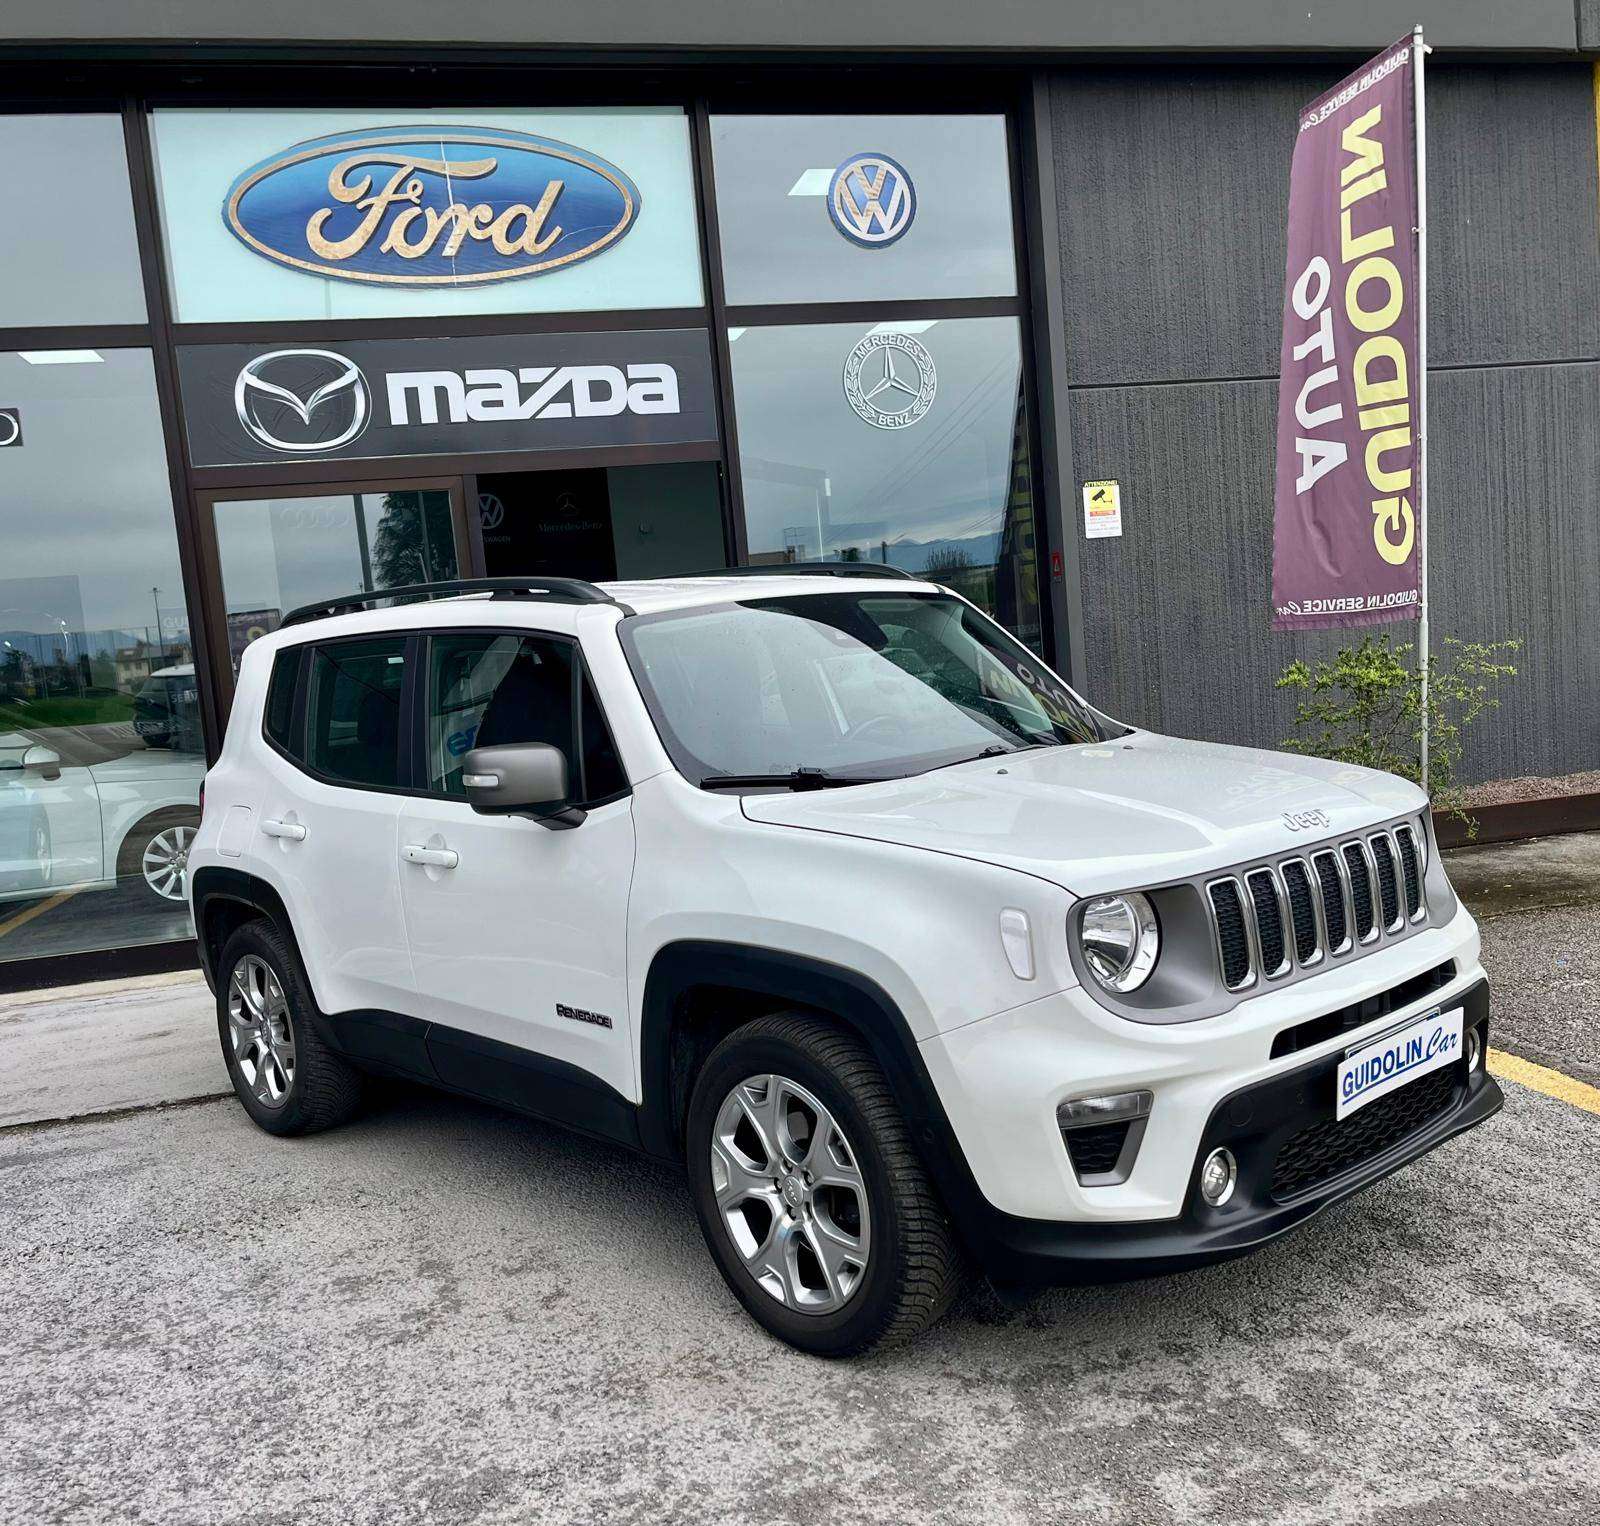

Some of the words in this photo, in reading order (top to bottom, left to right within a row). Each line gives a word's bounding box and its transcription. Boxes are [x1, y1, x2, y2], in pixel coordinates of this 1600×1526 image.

[306, 154, 564, 260] Ford
[855, 334, 921, 360] MERCEDES
[878, 411, 912, 427] BENZ
[1281, 808, 1330, 832] Jeep
[556, 1003, 613, 1029] RENEGADE
[1342, 1036, 1423, 1098] GUIDOLIN
[1426, 1026, 1458, 1061] Car
